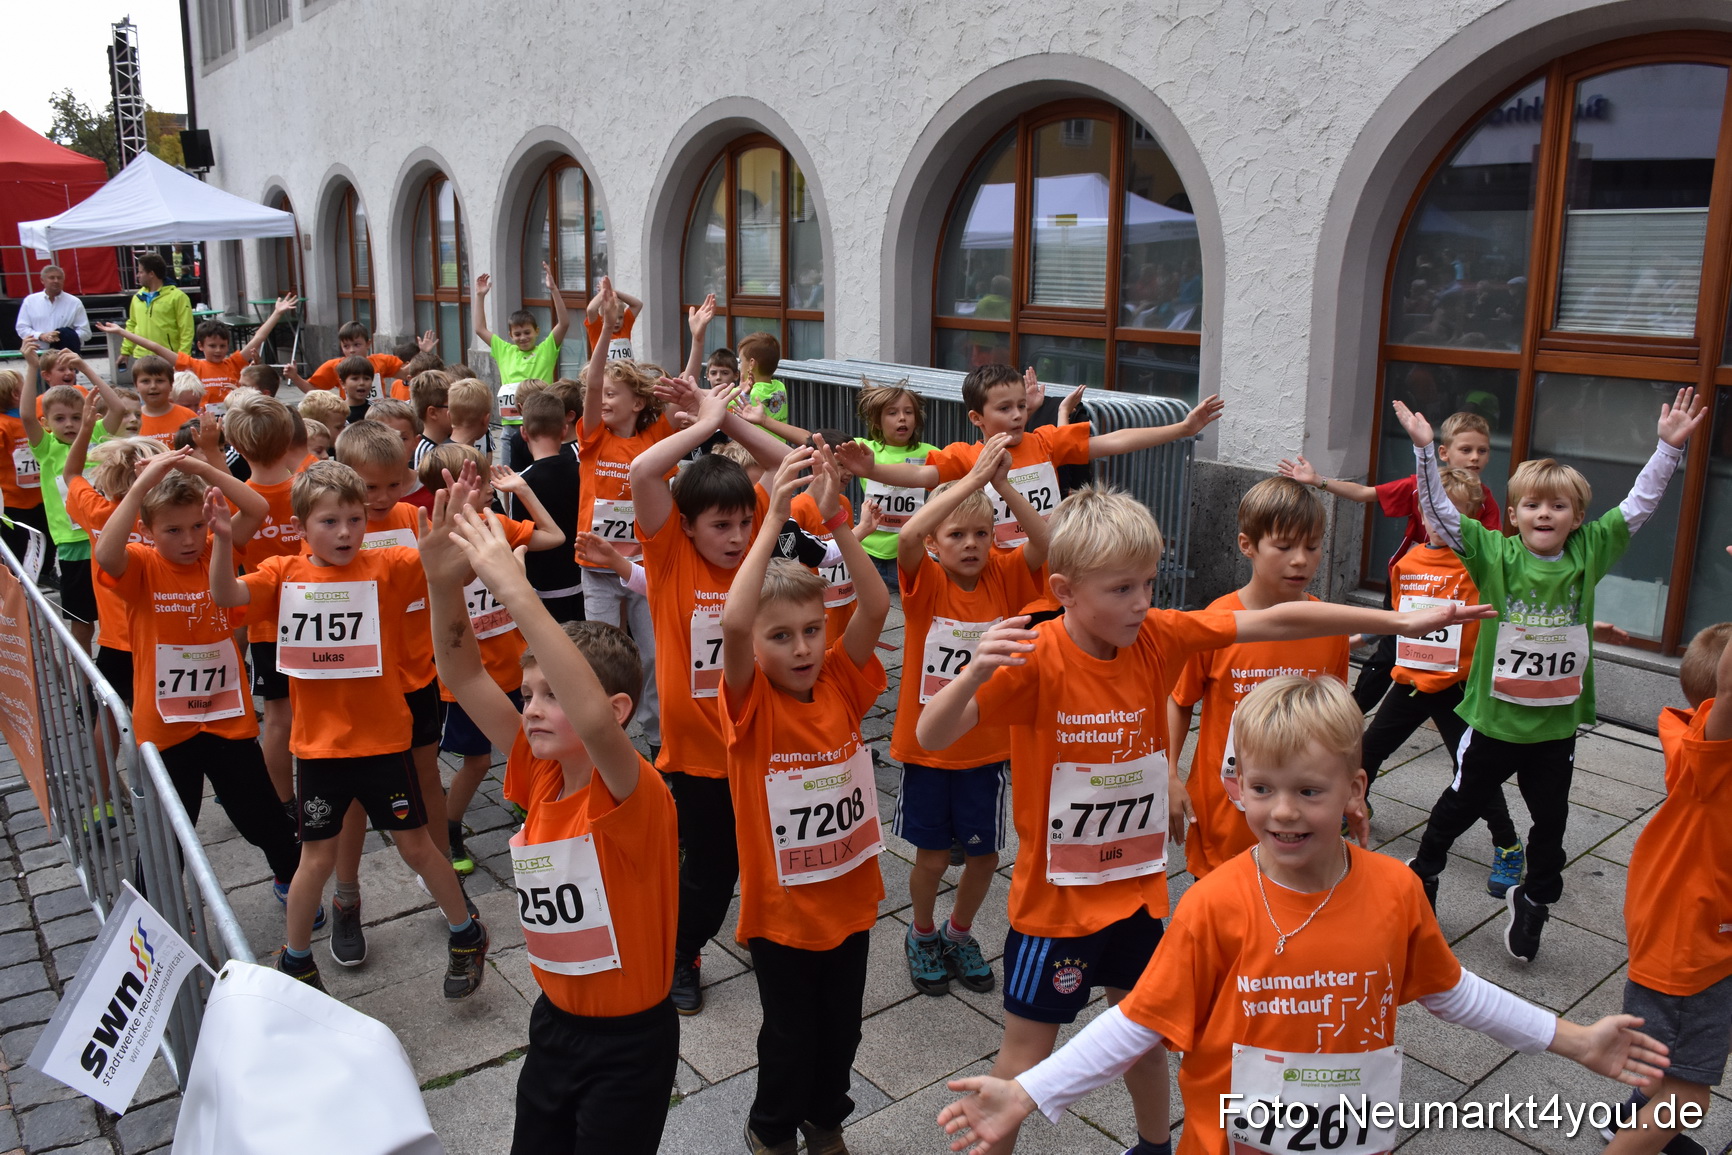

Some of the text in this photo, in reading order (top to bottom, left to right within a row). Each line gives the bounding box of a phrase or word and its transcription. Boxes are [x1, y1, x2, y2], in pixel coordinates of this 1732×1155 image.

[610, 347, 631, 359] 7190
[502, 394, 515, 406] 70
[597, 460, 631, 470] Neumark
[874, 494, 915, 512] 7106
[999, 487, 1053, 518] 752
[603, 519, 635, 539] 721
[369, 538, 398, 548] BOCK
[828, 562, 848, 582] 71
[314, 591, 350, 600] BOCK
[292, 612, 363, 641] 7157
[1535, 634, 1567, 642] BOCK
[192, 649, 220, 660] BOCK
[312, 652, 345, 662] Lukas
[939, 646, 972, 675] 72
[1405, 645, 1434, 660] Simon
[1511, 649, 1576, 676] 7316
[169, 665, 226, 692] 7171
[1231, 666, 1304, 678] Neumarkter
[1057, 709, 1139, 725] Neumarkter
[1056, 728, 1124, 744] Stadtlauf
[770, 747, 842, 763] eumarkter
[1104, 769, 1143, 786] BOCK
[790, 787, 865, 840] 7208
[1070, 793, 1154, 838] 7777
[1052, 832, 1062, 840] B4
[789, 836, 853, 870] FELIX
[1100, 847, 1123, 862] Luis
[517, 883, 584, 926] 250
[1237, 970, 1358, 993] Neumarkter
[1242, 993, 1334, 1016] Stadtlauf
[81, 971, 145, 1079] swn
[103, 961, 164, 1086] stadtwerke neumarkt
[130, 1046, 140, 1063] wir
[139, 1016, 155, 1047] bieten
[1302, 1068, 1361, 1082] BOCK
